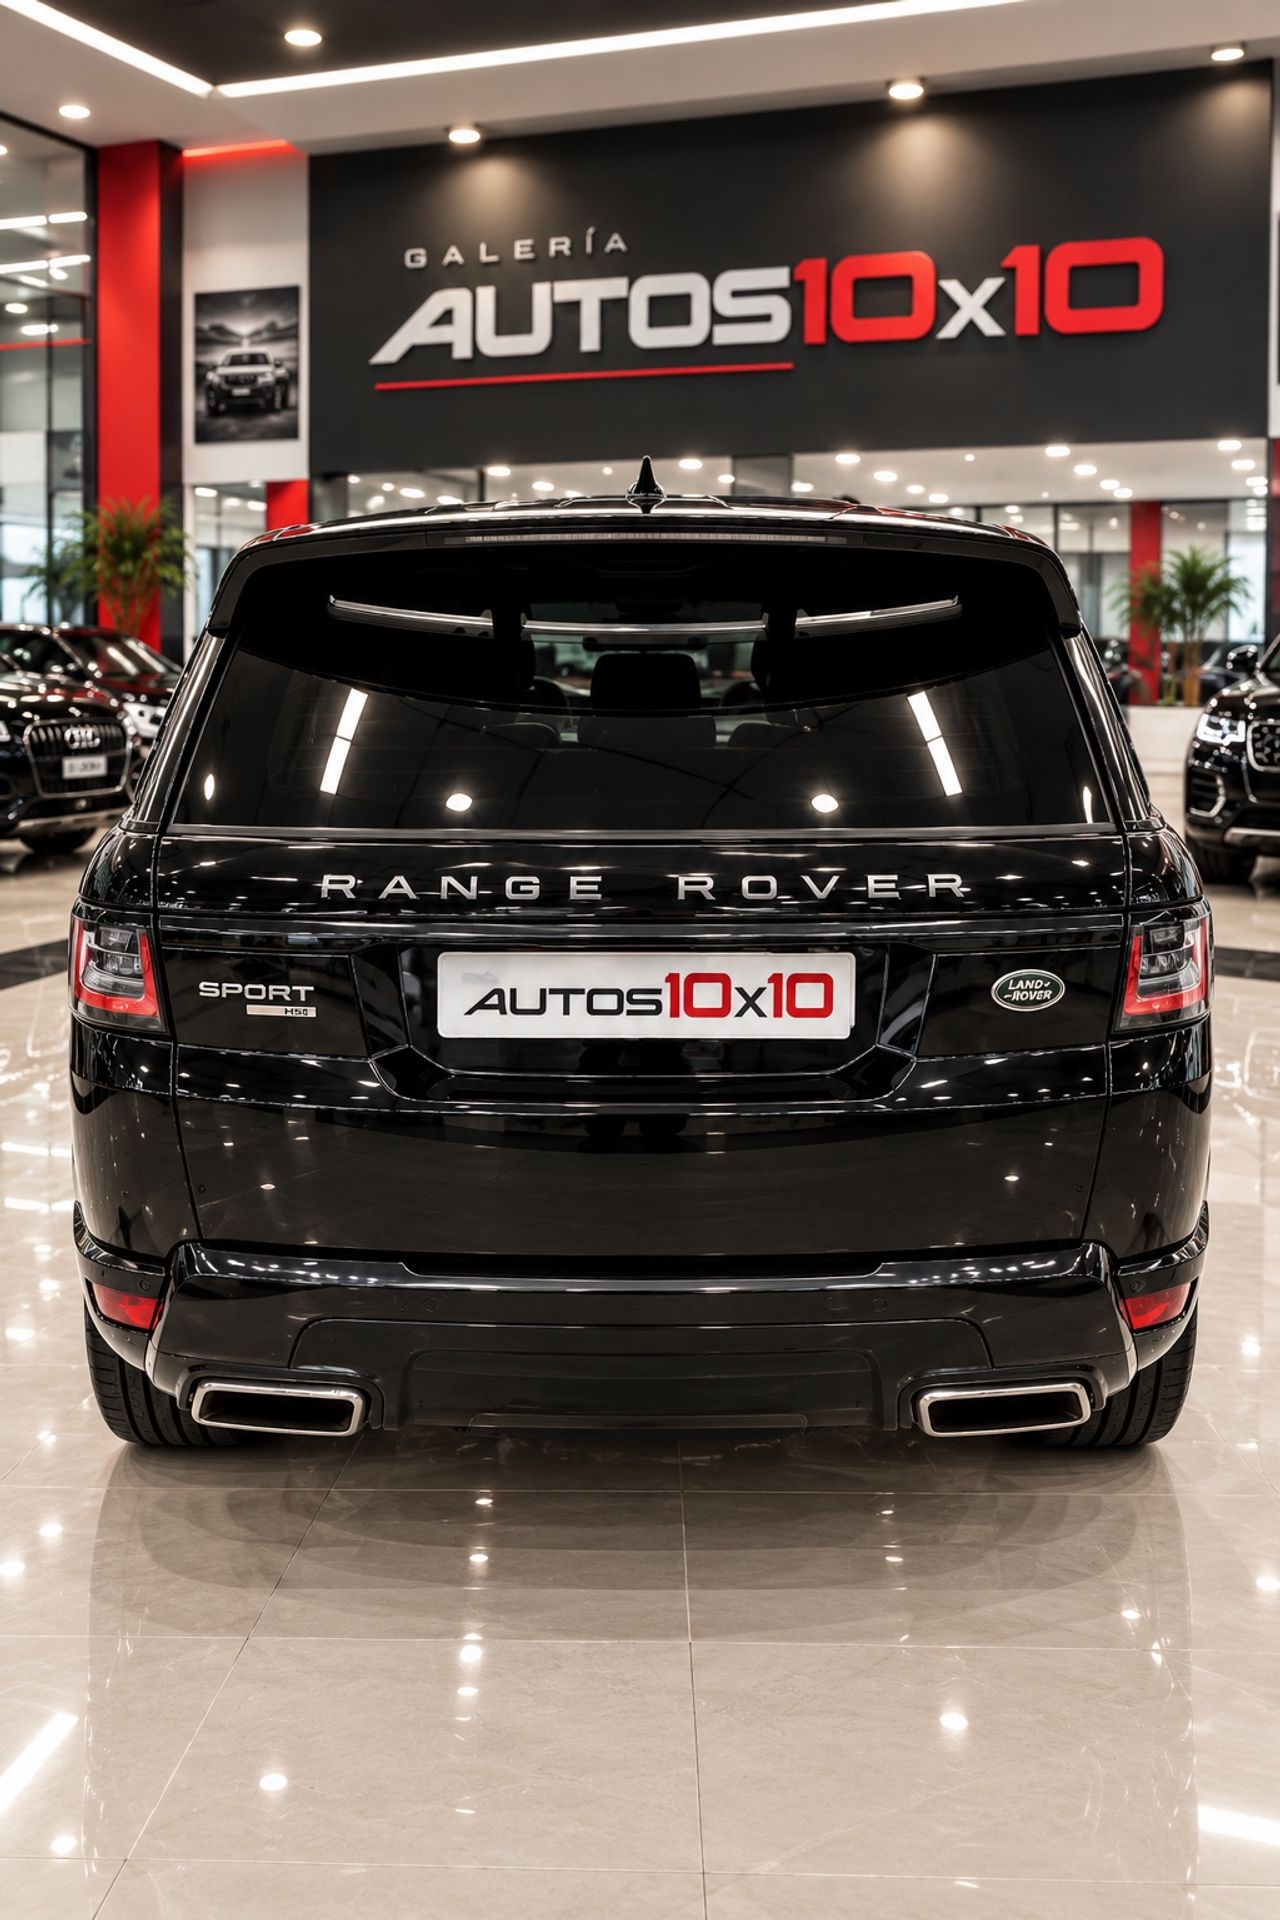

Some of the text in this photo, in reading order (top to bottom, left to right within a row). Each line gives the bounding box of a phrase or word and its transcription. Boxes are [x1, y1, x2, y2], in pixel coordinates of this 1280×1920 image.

[403, 226, 628, 269] GALERÍA
[320, 873, 965, 900] RANGE ROVER
[198, 981, 315, 1002] SPORT
